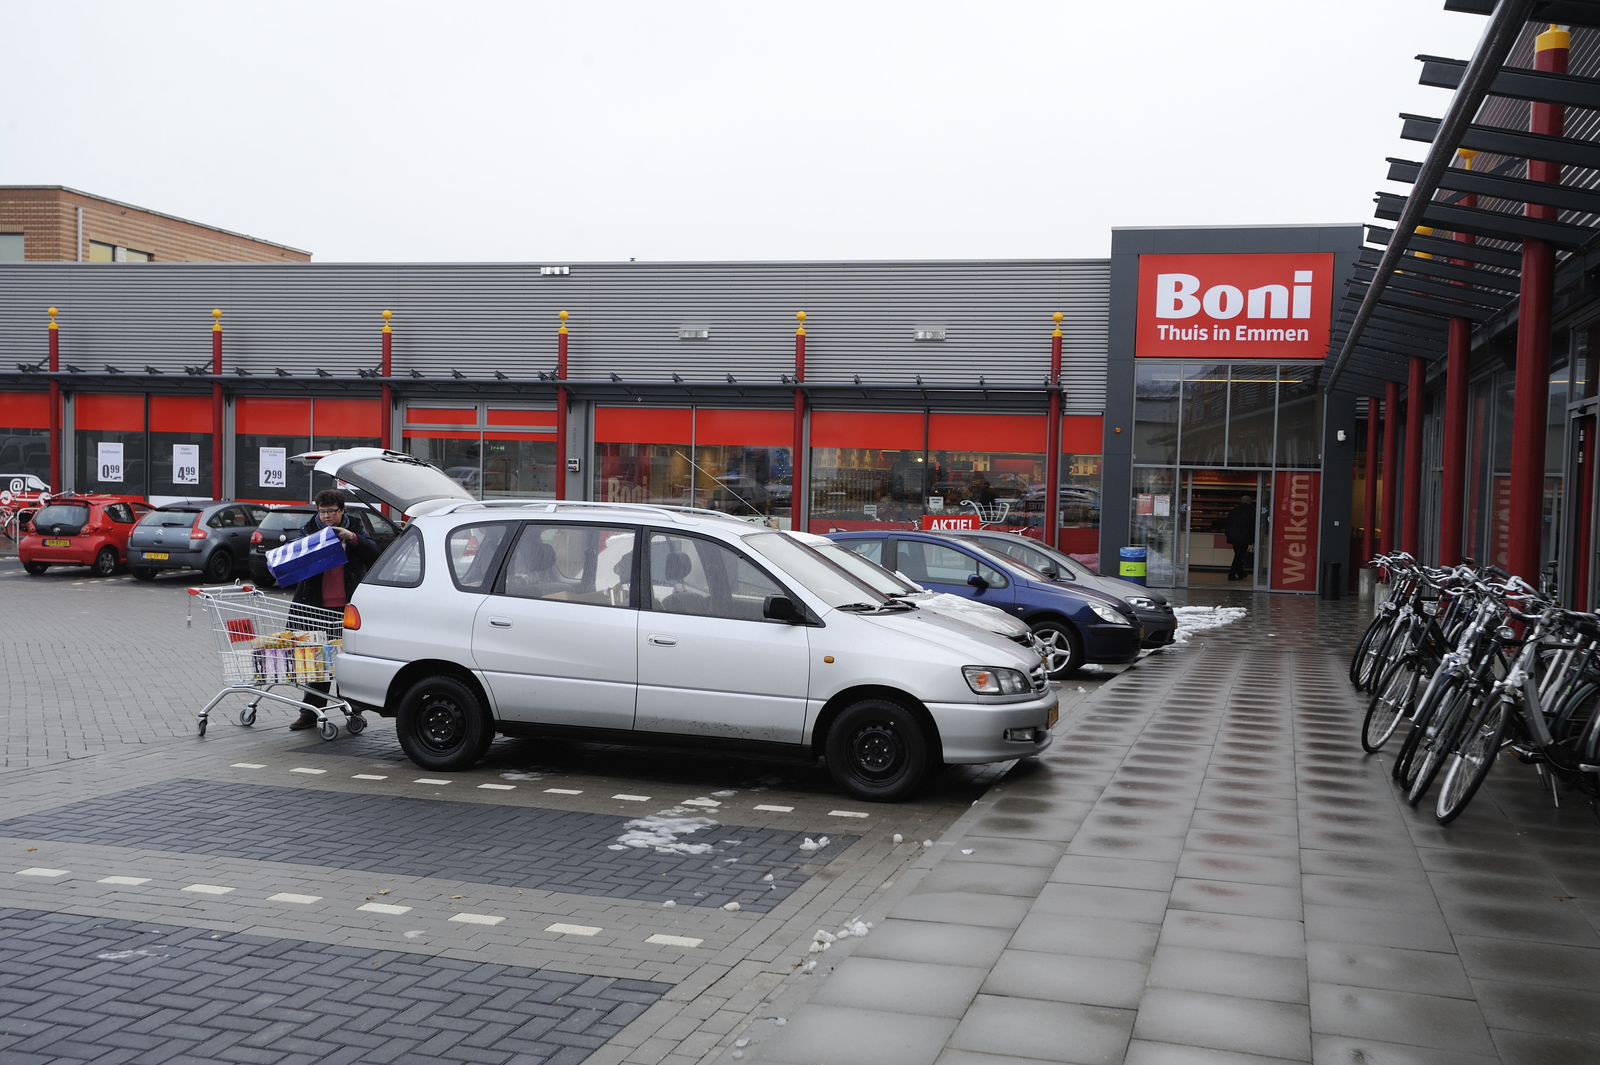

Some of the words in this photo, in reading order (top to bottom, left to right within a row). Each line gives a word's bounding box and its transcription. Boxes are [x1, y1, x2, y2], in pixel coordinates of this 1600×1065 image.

[1156, 270, 1313, 319] Boni
[1157, 324, 1208, 341] Thuis
[1213, 324, 1231, 341] in
[1235, 325, 1309, 342] Emmen
[931, 519, 973, 531] AKTIE!
[1282, 475, 1309, 584] Welkom
